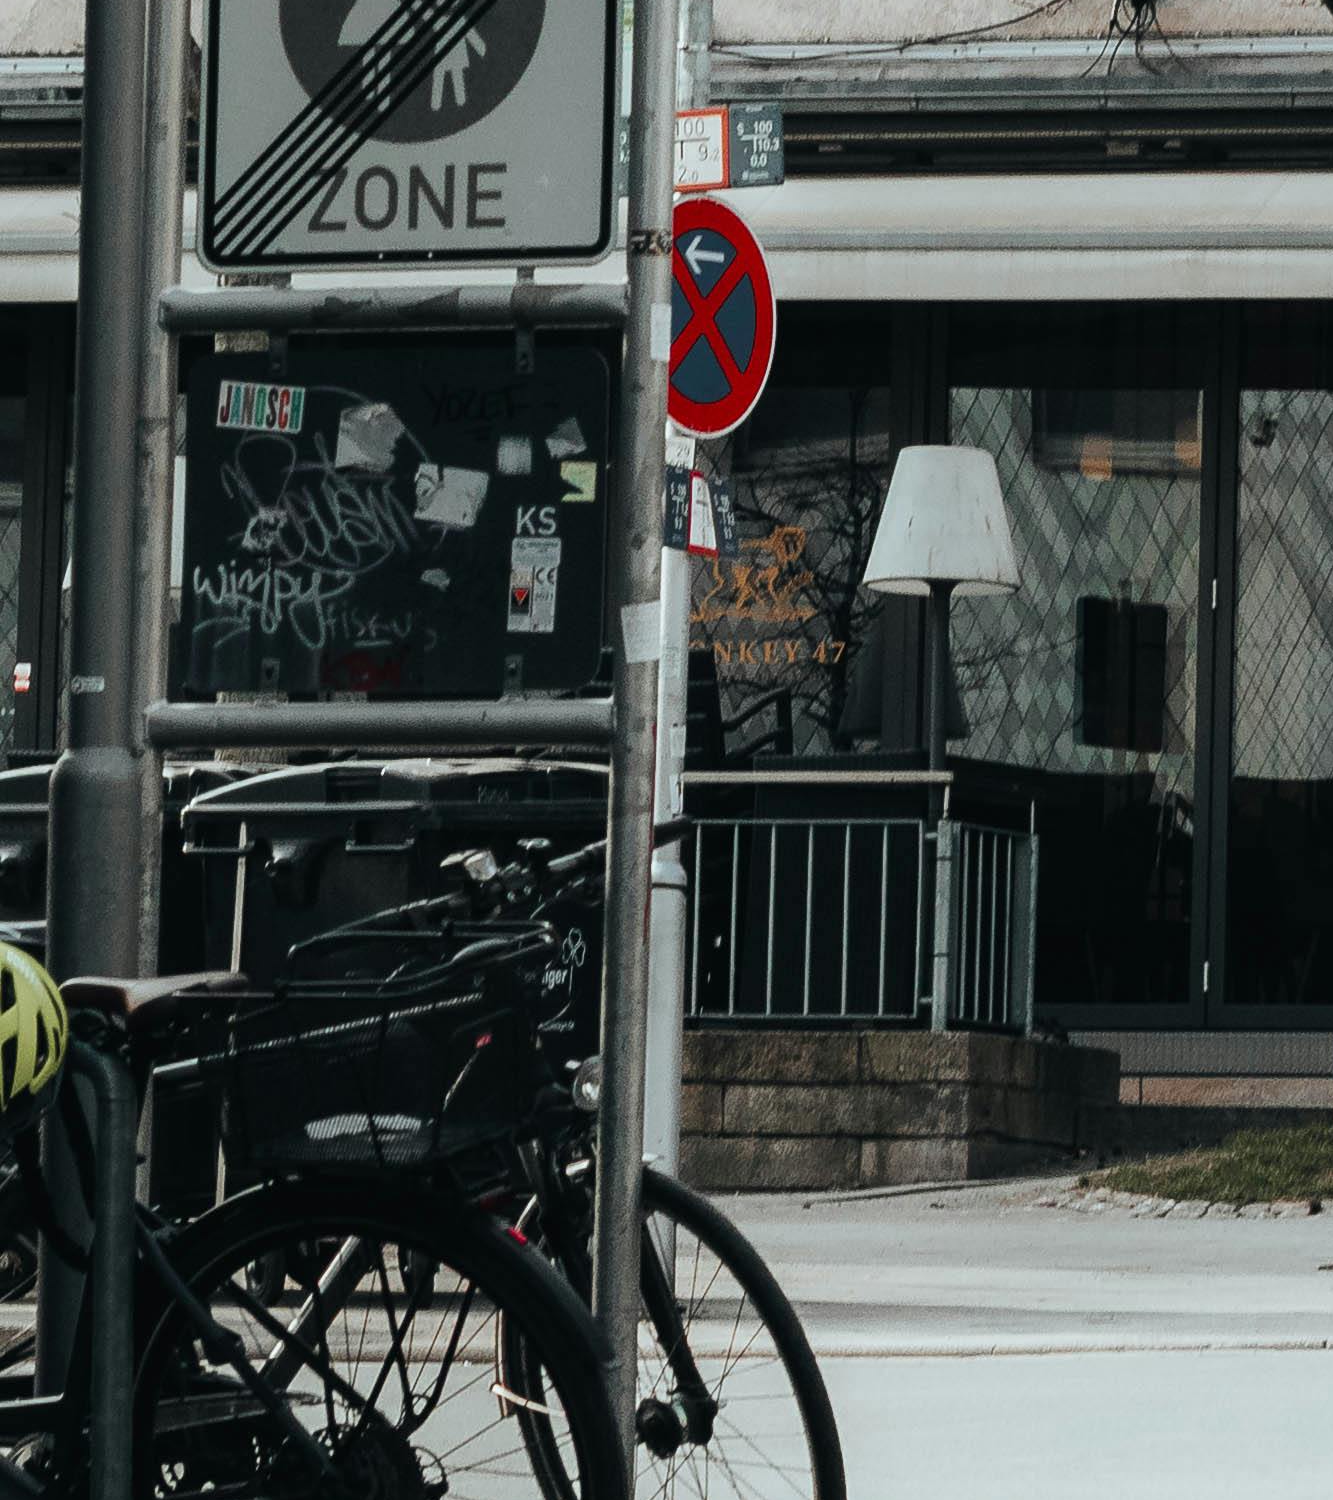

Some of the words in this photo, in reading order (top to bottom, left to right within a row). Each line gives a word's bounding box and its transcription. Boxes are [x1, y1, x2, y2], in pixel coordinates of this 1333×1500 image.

[308, 163, 508, 233] ZONE
[219, 383, 302, 431] JANOSCH
[516, 505, 556, 536] KS
[688, 638, 799, 665] NKEY
[812, 638, 847, 664] 47
